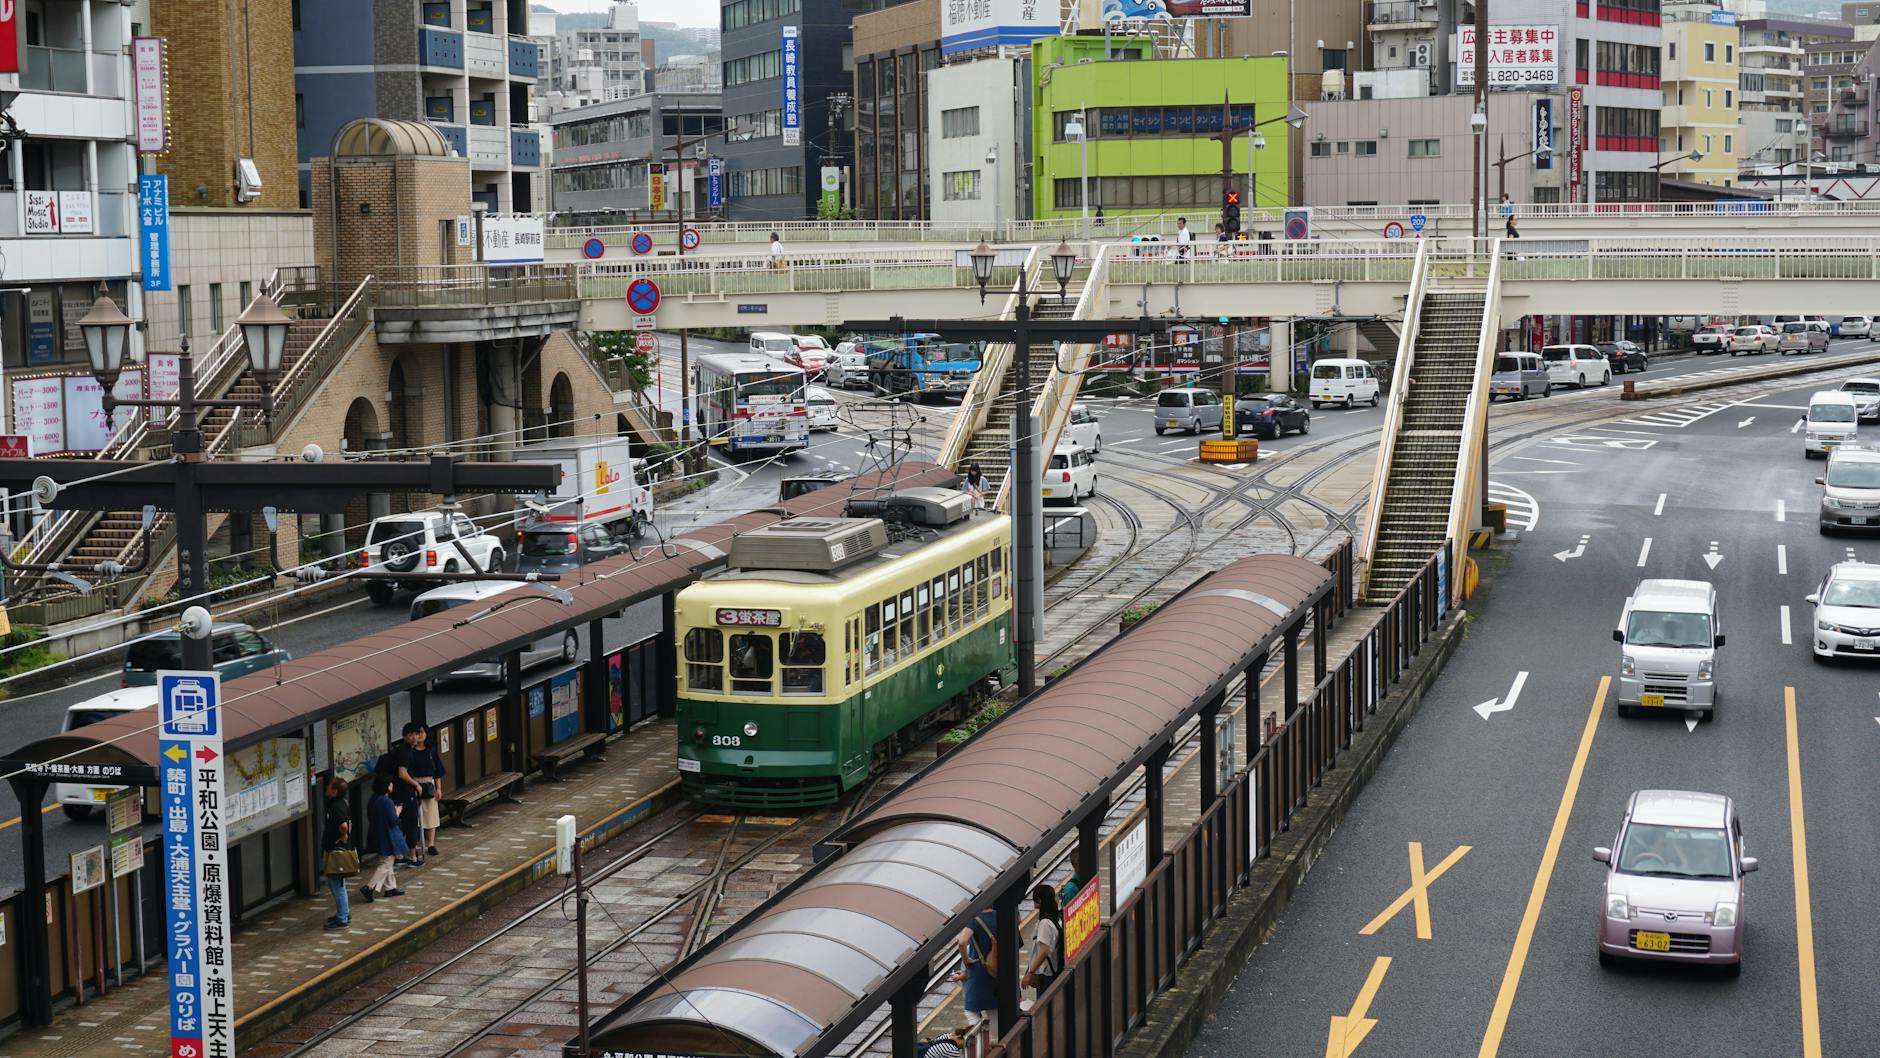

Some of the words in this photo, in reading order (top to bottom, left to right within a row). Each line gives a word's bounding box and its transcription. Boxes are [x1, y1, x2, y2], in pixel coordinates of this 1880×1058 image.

[1461, 48, 1554, 64] 店入居者募集
[1497, 70, 1555, 81] 820-3468
[785, 39, 797, 126] 長崎教員養成塾
[711, 164, 719, 172] P
[153, 179, 164, 226] アナミビル
[1412, 218, 1425, 226] 202
[1388, 227, 1400, 238] 50
[719, 609, 738, 624] 3
[712, 735, 741, 746] 303
[102, 766, 122, 776] のりば
[166, 767, 194, 988] 築町・出島・大浦天主堂・グラバー園
[175, 991, 197, 1031] のりば
